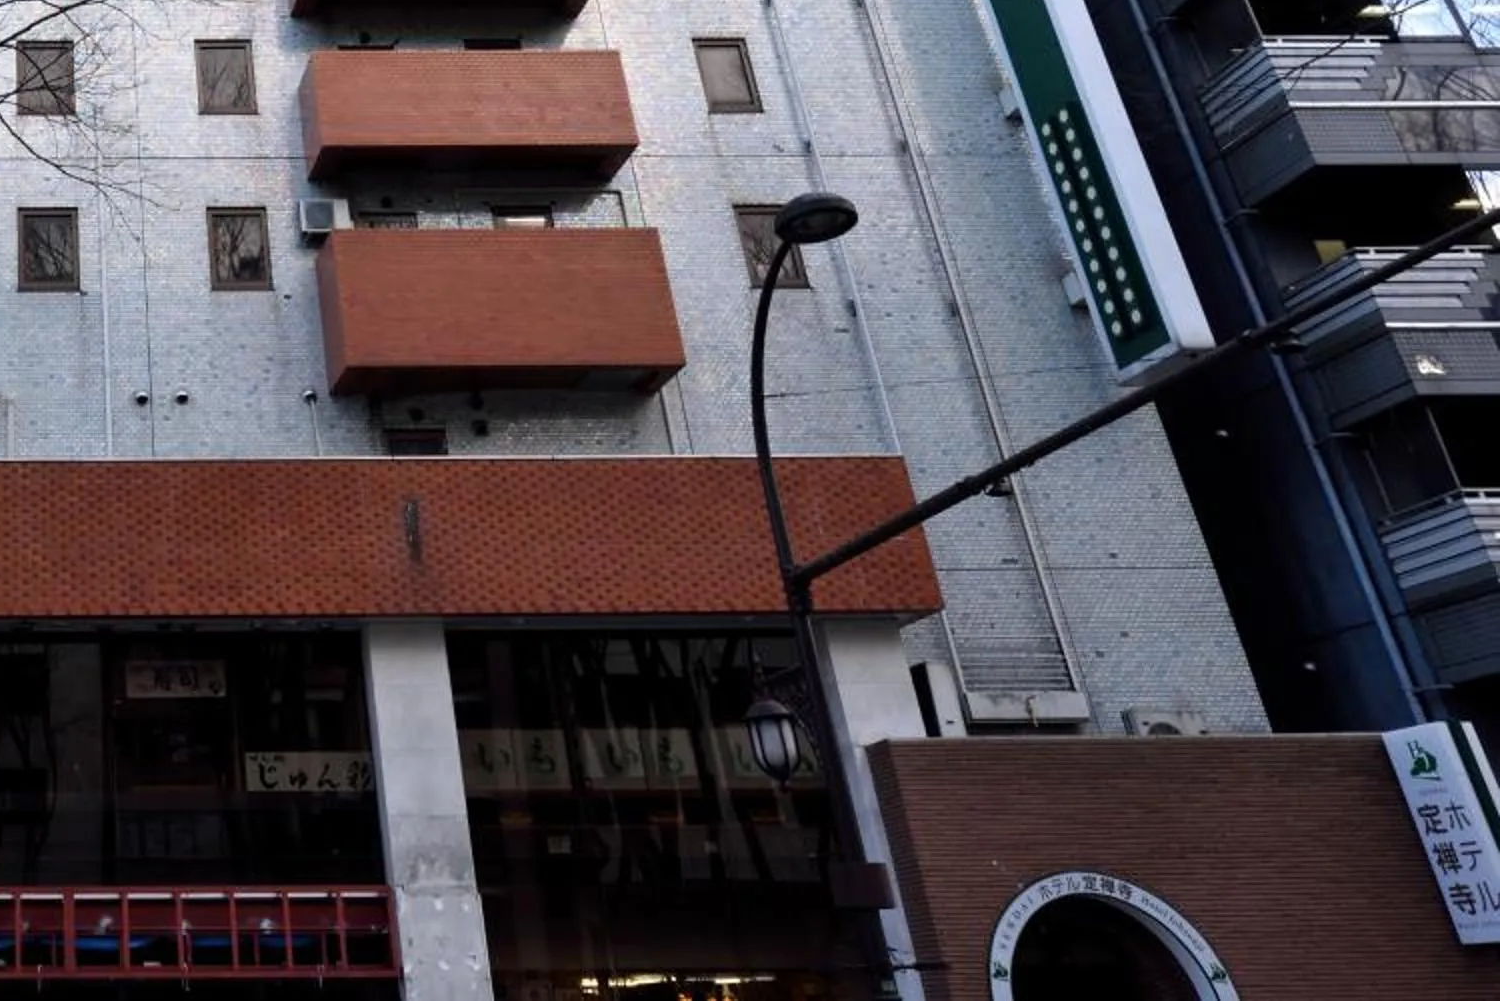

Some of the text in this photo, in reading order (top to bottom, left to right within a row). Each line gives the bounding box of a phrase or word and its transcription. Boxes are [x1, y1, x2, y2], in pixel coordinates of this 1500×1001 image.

[1416, 802, 1477, 916] 定禅寺
[1444, 800, 1500, 913] ホテル
